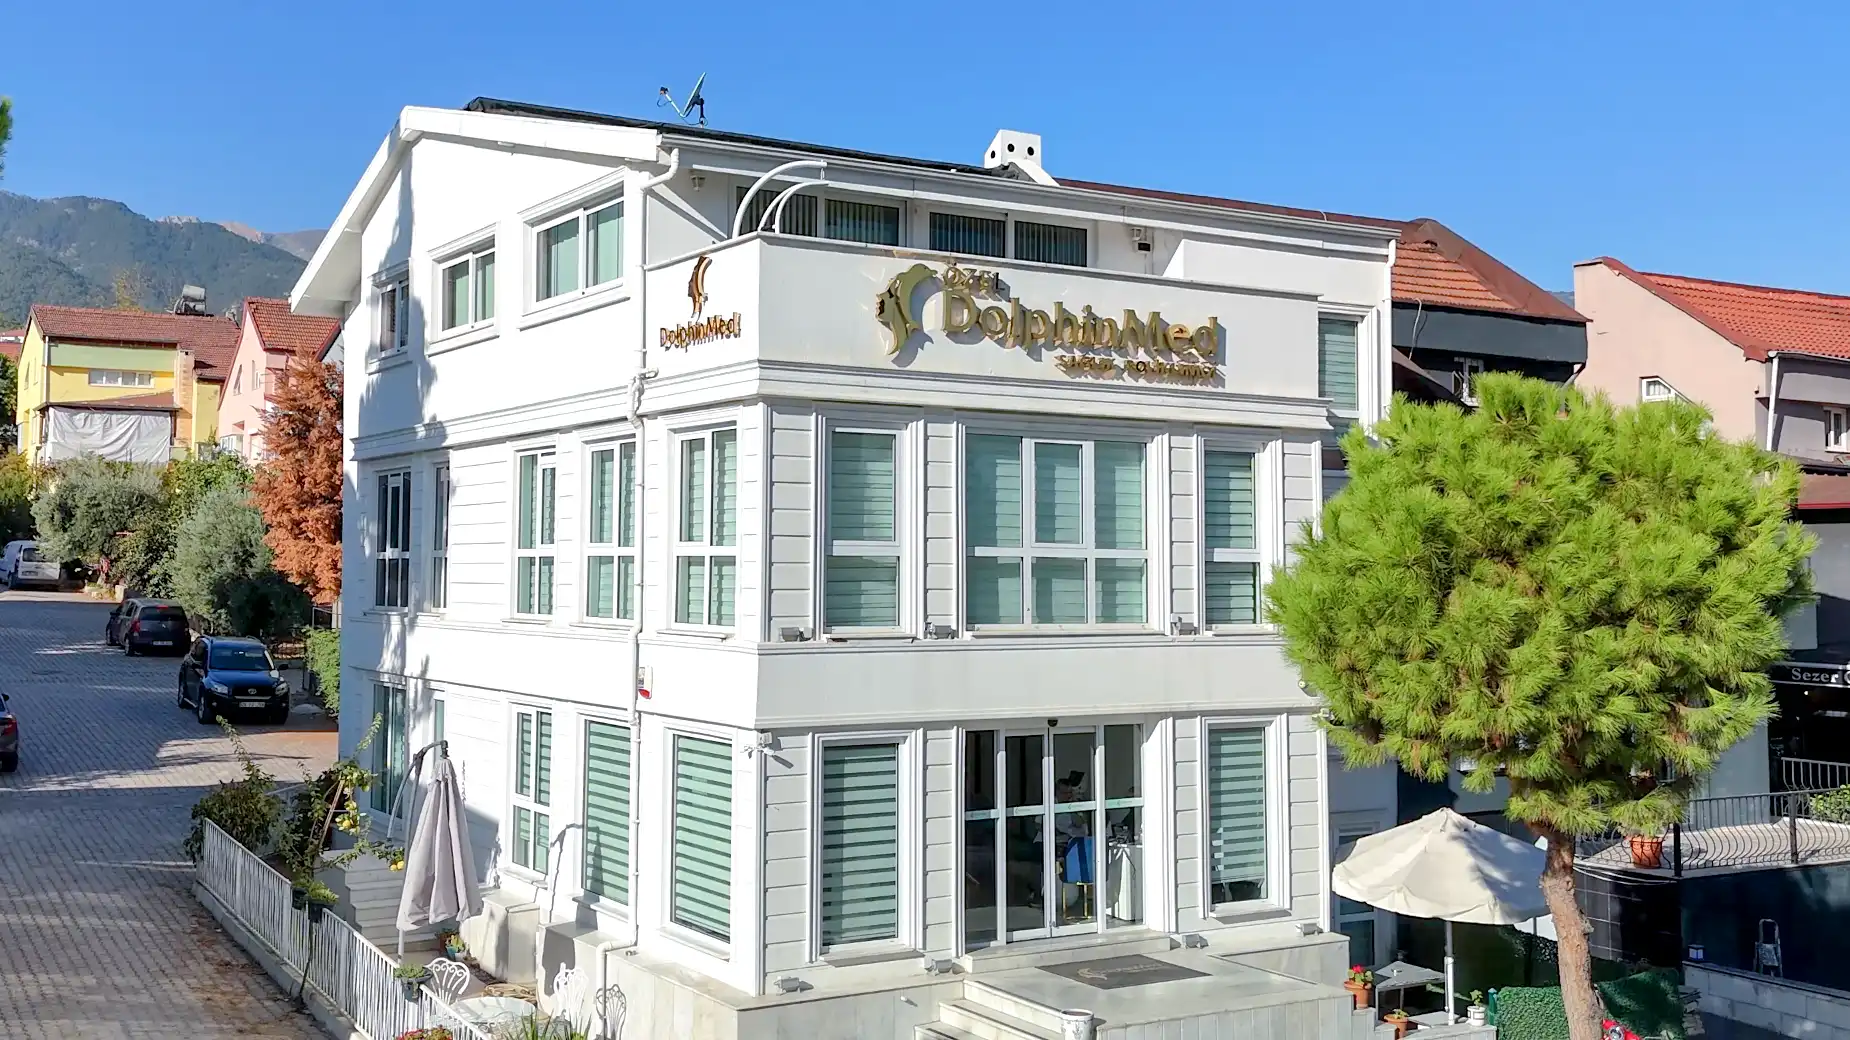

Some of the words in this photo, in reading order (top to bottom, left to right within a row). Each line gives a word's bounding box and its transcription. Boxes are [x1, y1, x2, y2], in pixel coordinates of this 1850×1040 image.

[660, 312, 741, 349] DolphinMed
[942, 287, 1218, 358] DolphinMed
[1791, 667, 1839, 683] Sezer
